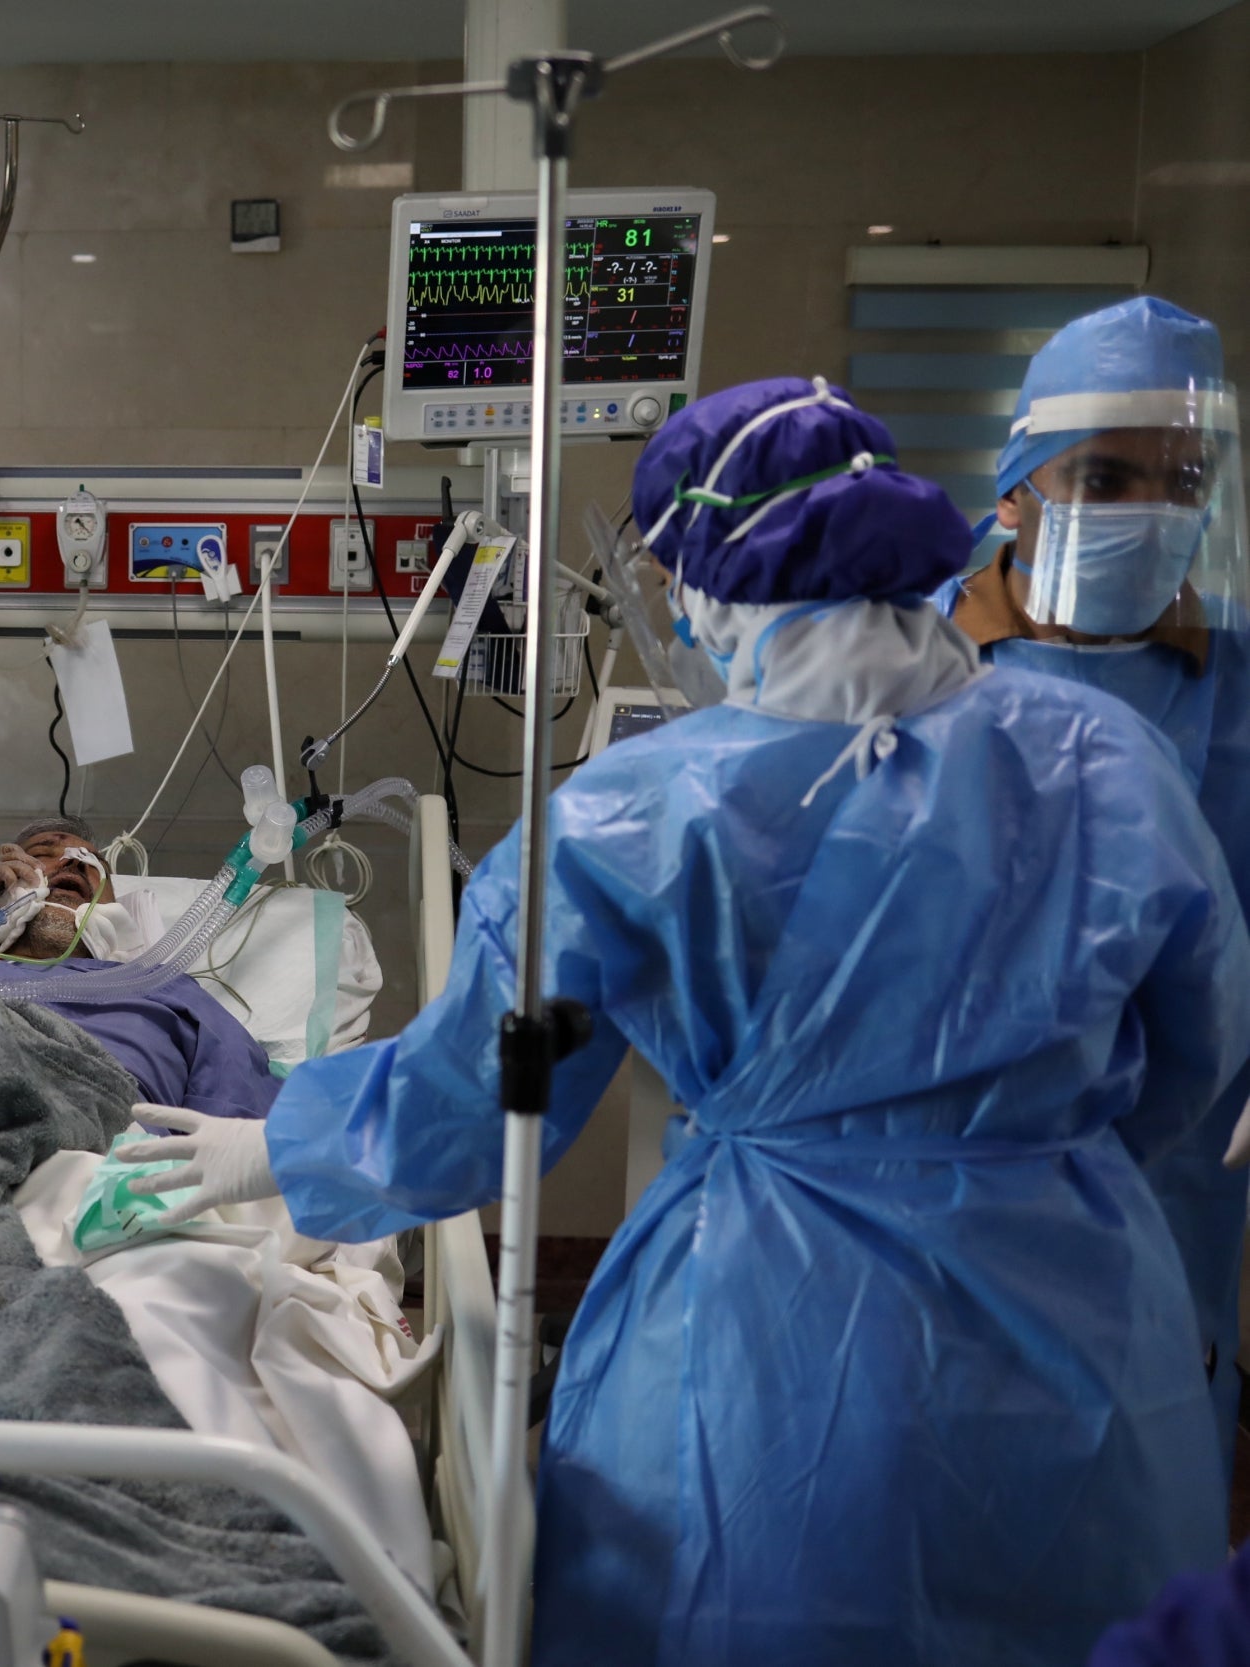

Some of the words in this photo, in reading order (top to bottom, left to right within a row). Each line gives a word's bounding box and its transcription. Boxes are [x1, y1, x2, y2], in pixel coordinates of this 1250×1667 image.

[453, 210, 481, 218] SAADAT
[595, 220, 609, 229] HR
[625, 228, 652, 248] 81
[617, 287, 635, 303] 31
[473, 366, 493, 379] 1.0
